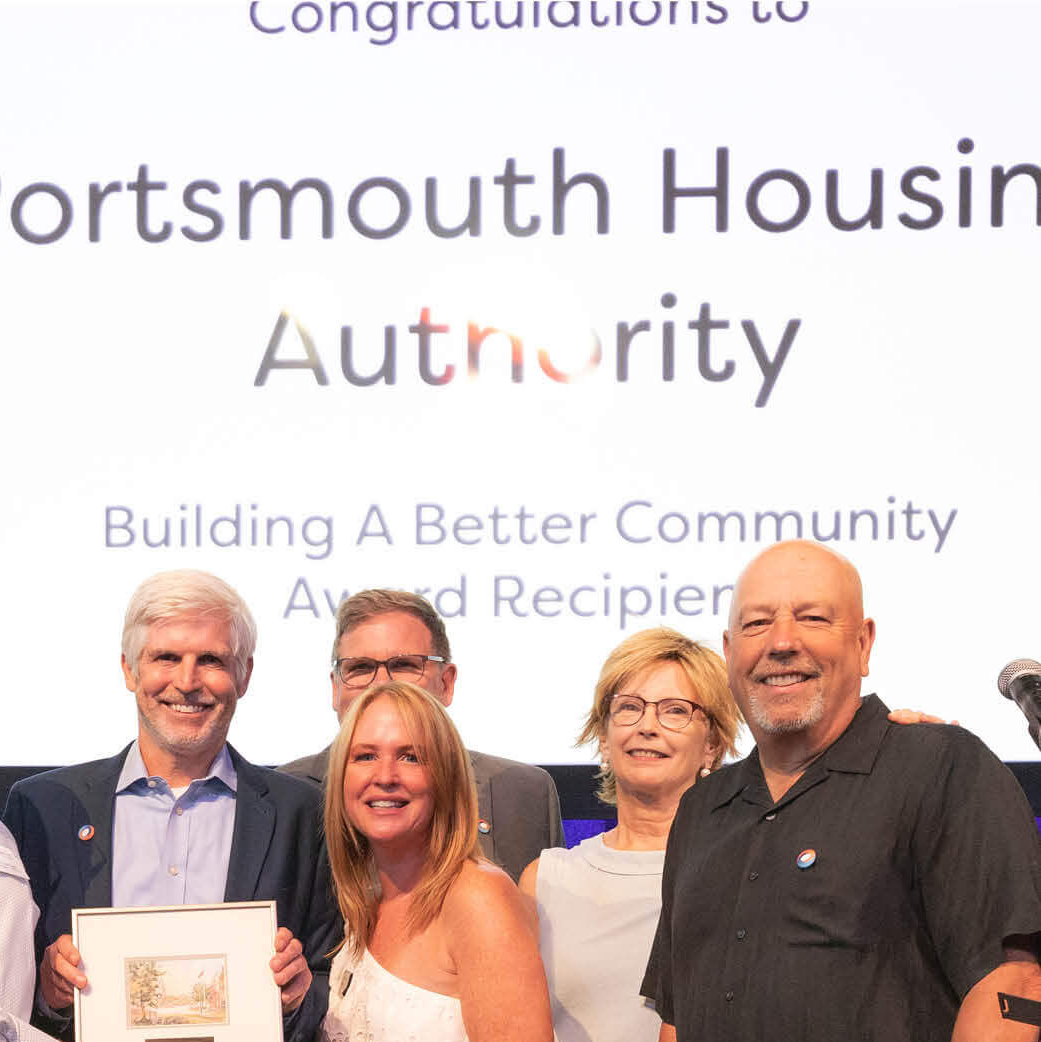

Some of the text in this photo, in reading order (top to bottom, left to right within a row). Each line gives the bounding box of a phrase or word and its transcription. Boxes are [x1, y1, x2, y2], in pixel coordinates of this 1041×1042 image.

[105, 495, 958, 560] Building A Better Community
